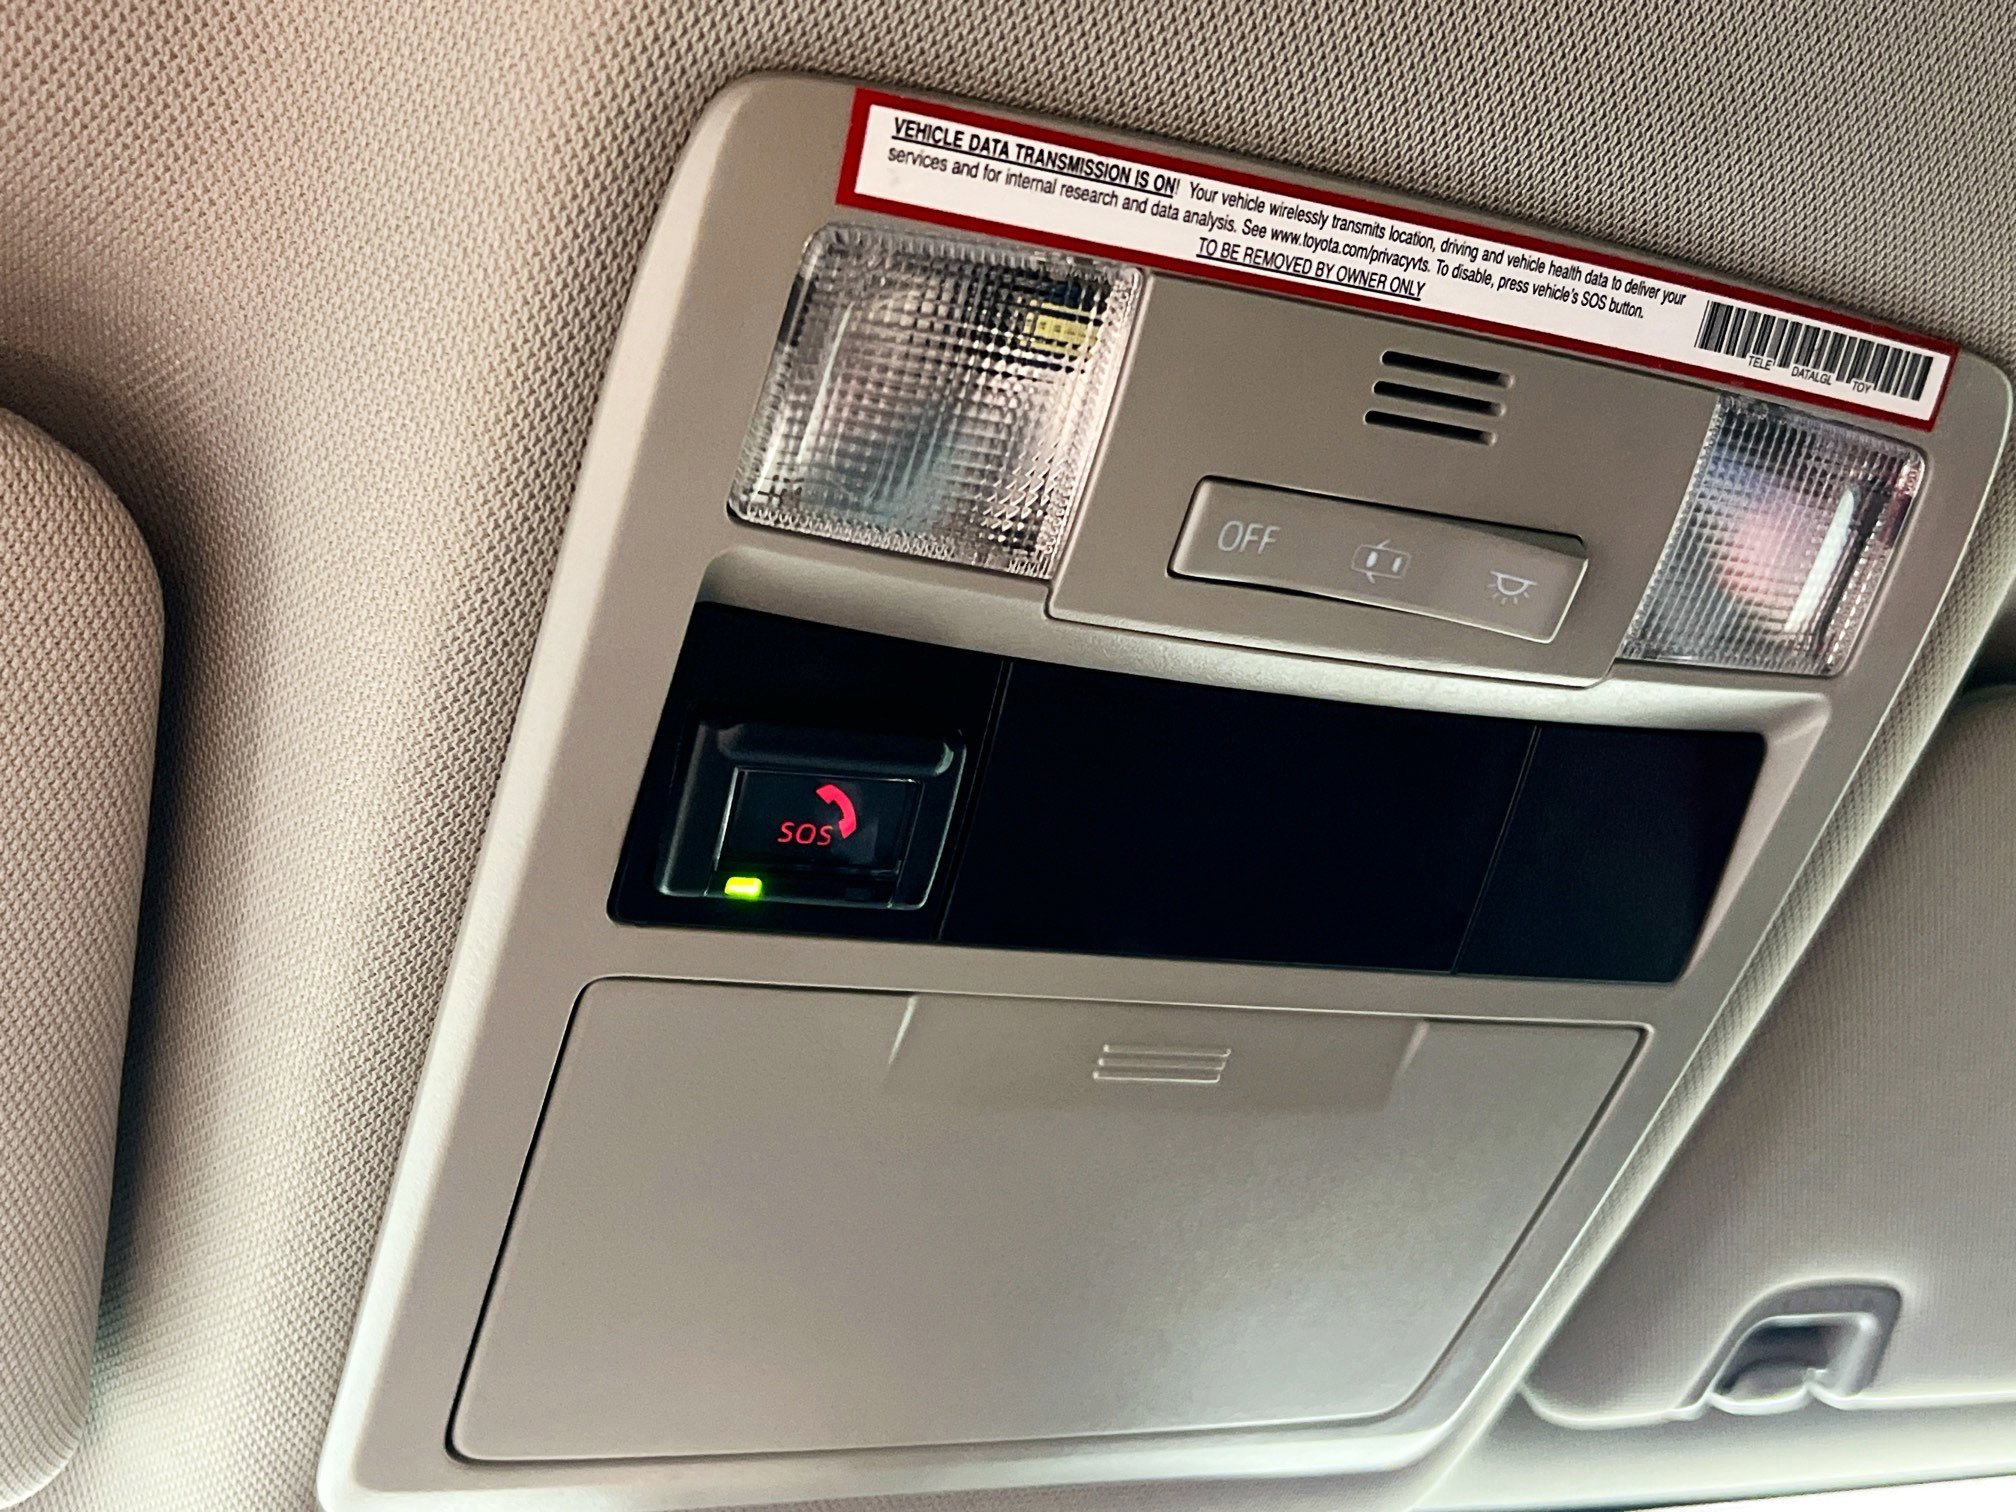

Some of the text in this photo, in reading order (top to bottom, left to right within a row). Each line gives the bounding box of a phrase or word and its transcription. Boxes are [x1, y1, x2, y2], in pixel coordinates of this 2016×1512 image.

[888, 146, 948, 172] services
[952, 161, 978, 179] and
[983, 165, 1003, 184] for
[1005, 169, 1057, 195] internal
[1060, 181, 1118, 208] research
[1122, 195, 1146, 214] and
[1150, 201, 1179, 221] data
[1183, 210, 1237, 233] analysis.
[1242, 218, 1267, 238] See
[1436, 258, 1449, 277] To
[1451, 263, 1494, 288] disable,
[1497, 276, 1529, 294] press
[1532, 281, 1578, 304] vehicle's
[1580, 290, 1607, 311] SOS
[1608, 296, 1644, 318] button.
[893, 117, 963, 149] VEHICLE
[968, 134, 1010, 159] DATA
[1015, 143, 1132, 183] TRANSMISSION
[1134, 170, 1149, 189] IS
[1190, 181, 1218, 202] Your
[1221, 190, 1265, 213] vehicle
[1269, 202, 1329, 230] wirelessly
[1332, 213, 1386, 239] transmits
[1389, 224, 1436, 252] location,
[1440, 237, 1478, 262] driving
[1481, 248, 1504, 264] and
[1507, 251, 1545, 274] vehicle
[1548, 260, 1581, 282] health
[1584, 269, 1609, 288] data
[1611, 276, 1622, 291] to
[1624, 277, 1660, 300] deliver
[1661, 288, 1687, 306] your
[1199, 237, 1426, 298] TO BE REMOVED BY OWNER ONLY
[1749, 356, 1873, 394] TELE DATALGL TOY
[1218, 521, 1280, 553] OFF
[777, 821, 833, 846] SOS
